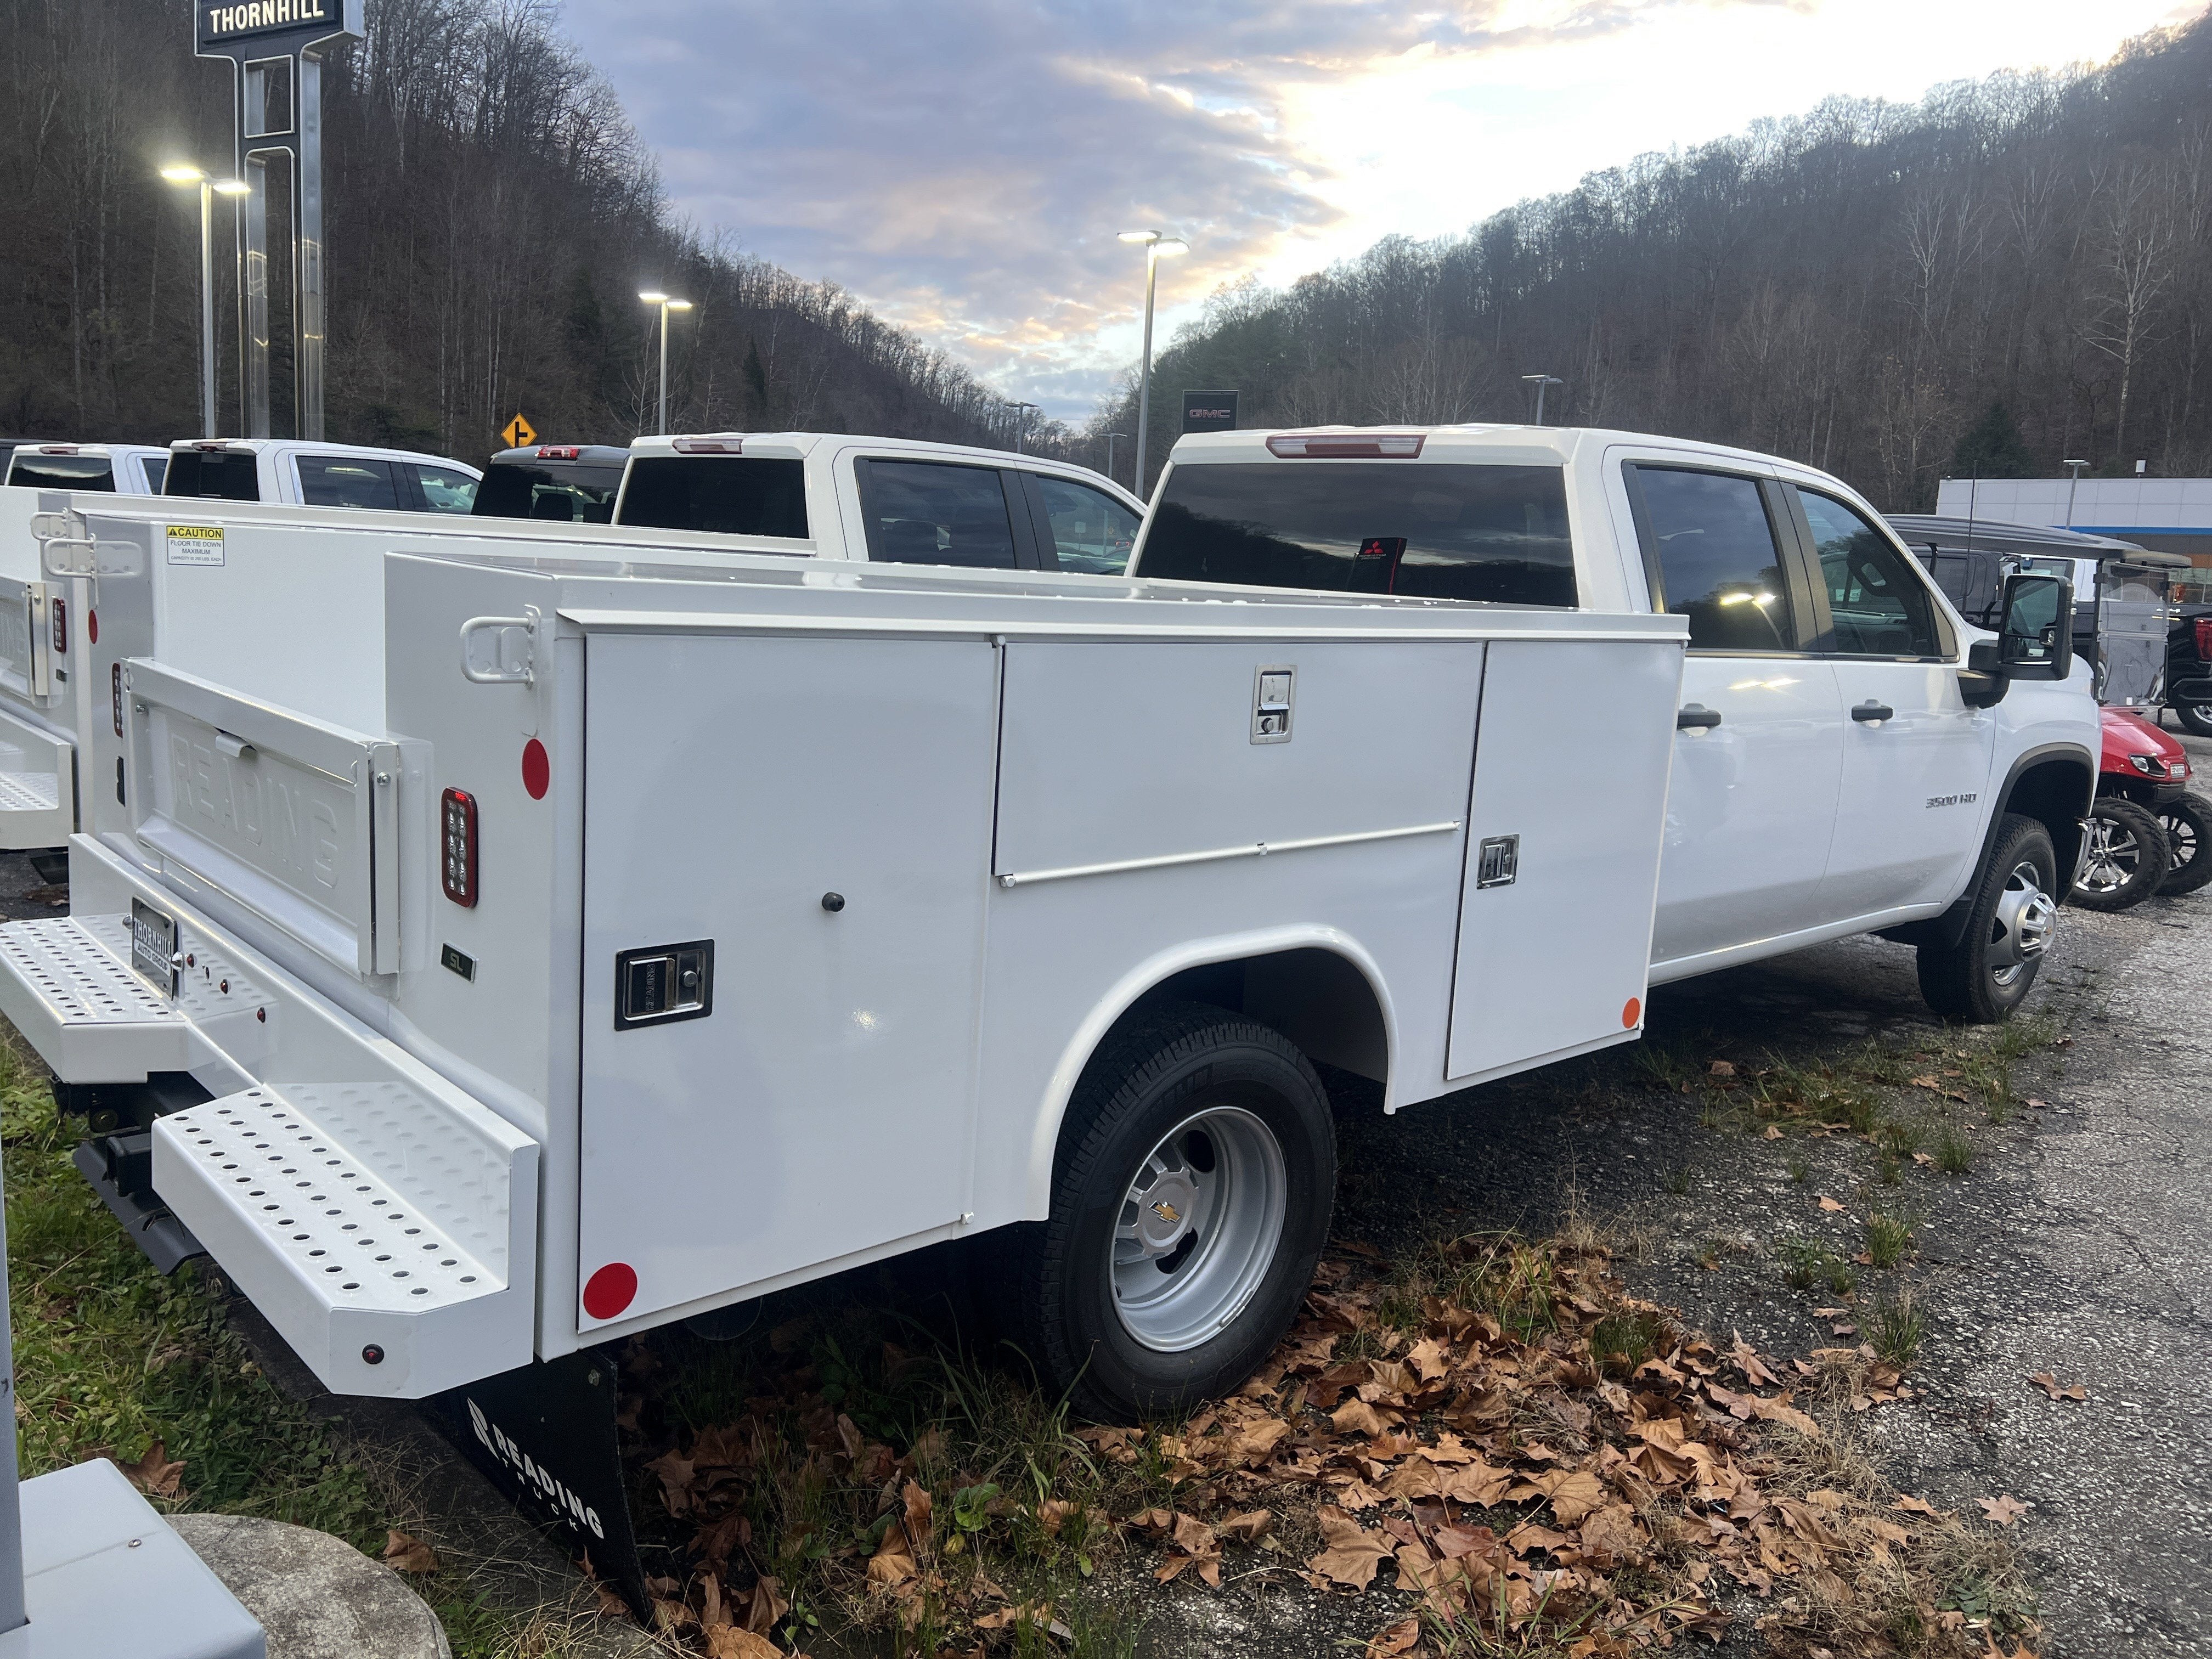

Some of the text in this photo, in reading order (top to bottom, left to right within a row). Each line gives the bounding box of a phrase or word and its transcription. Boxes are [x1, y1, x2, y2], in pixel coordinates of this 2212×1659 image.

[210, 0, 324, 33] THORNHILL
[1189, 409, 1231, 418] GMC
[178, 528, 222, 538] CAUTION
[1926, 793, 1977, 808] 3500 HD
[133, 917, 172, 961] THORNHILL
[138, 943, 168, 971] AUTO GROUP
[645, 963, 656, 1012] READING
[493, 1424, 604, 1539] READING
